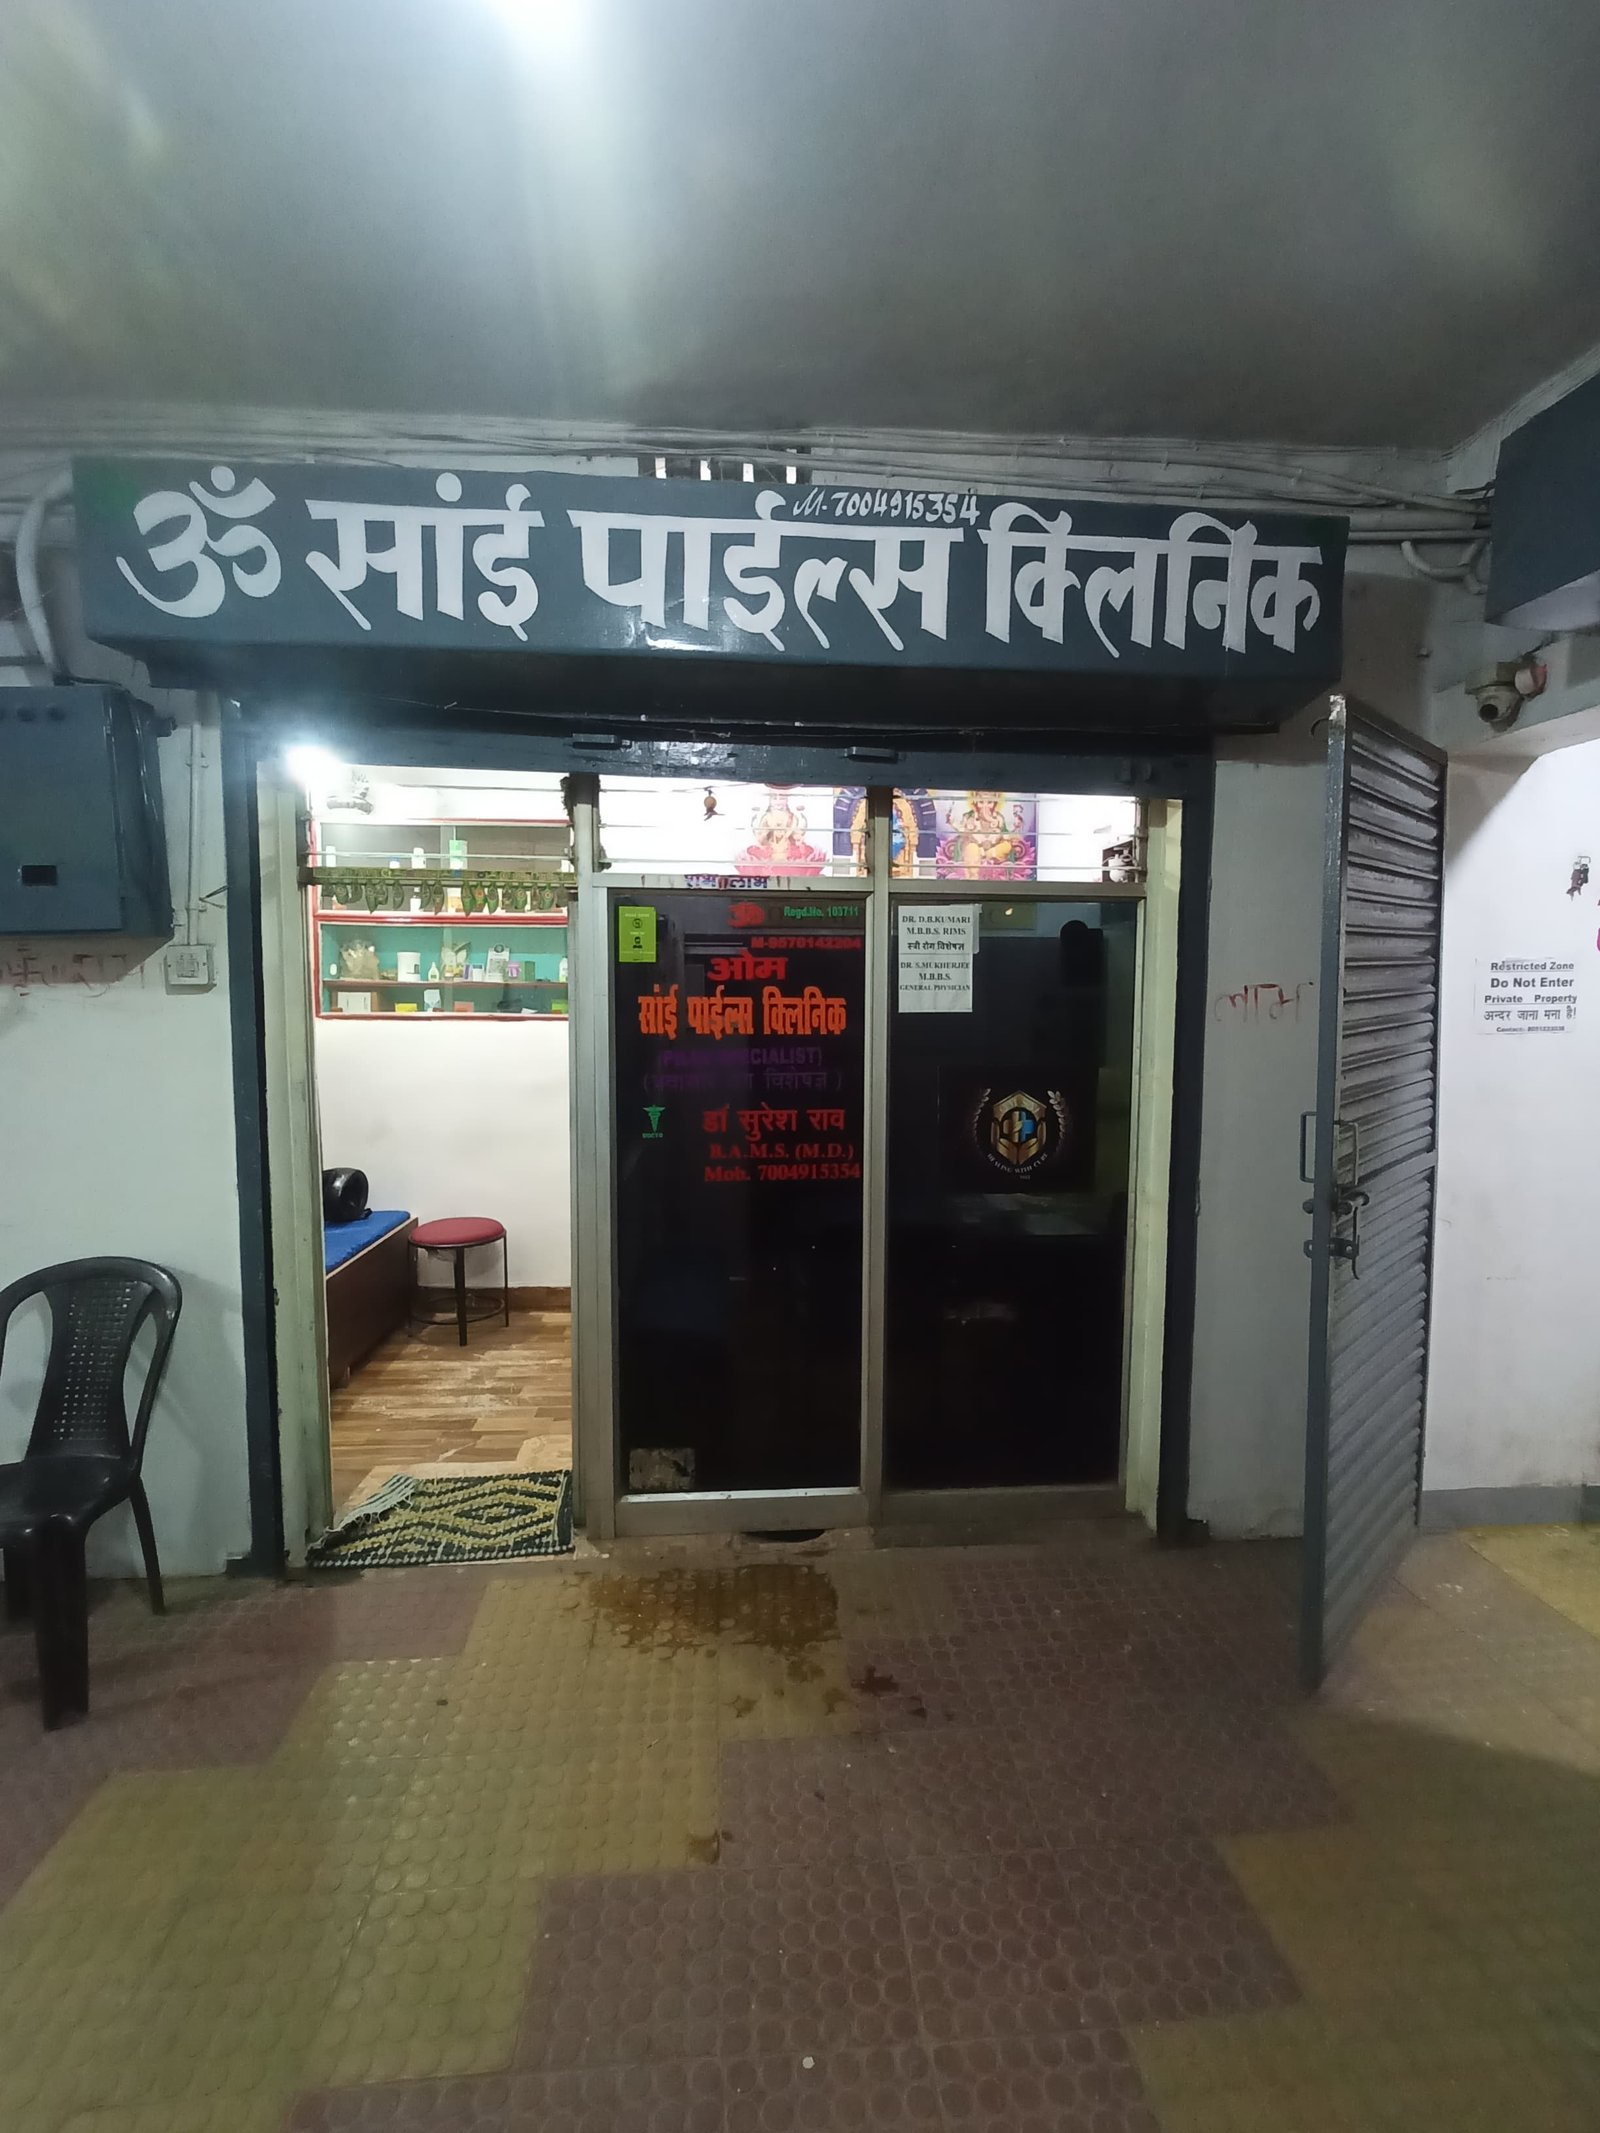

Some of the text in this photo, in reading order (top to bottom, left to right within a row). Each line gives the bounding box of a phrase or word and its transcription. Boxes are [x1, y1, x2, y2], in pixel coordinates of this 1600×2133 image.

[567, 490, 964, 651] पाईल्स
[977, 502, 1323, 658] क्लिनिक
[943, 927, 966, 935] RIMS
[707, 947, 788, 981] ओम
[1491, 962, 1574, 971] Restricted Zone
[1491, 977, 1574, 988] Do Not Enter
[1485, 994, 1577, 1004] Private Property
[762, 986, 847, 1035] क्लिनिक
[1484, 1010, 1511, 1020] अन्दर
[1517, 1009, 1538, 1020] जाना
[1544, 1009, 1560, 1019] मना
[736, 1101, 798, 1141] सुरेश
[757, 1163, 861, 1181] 7004915354
